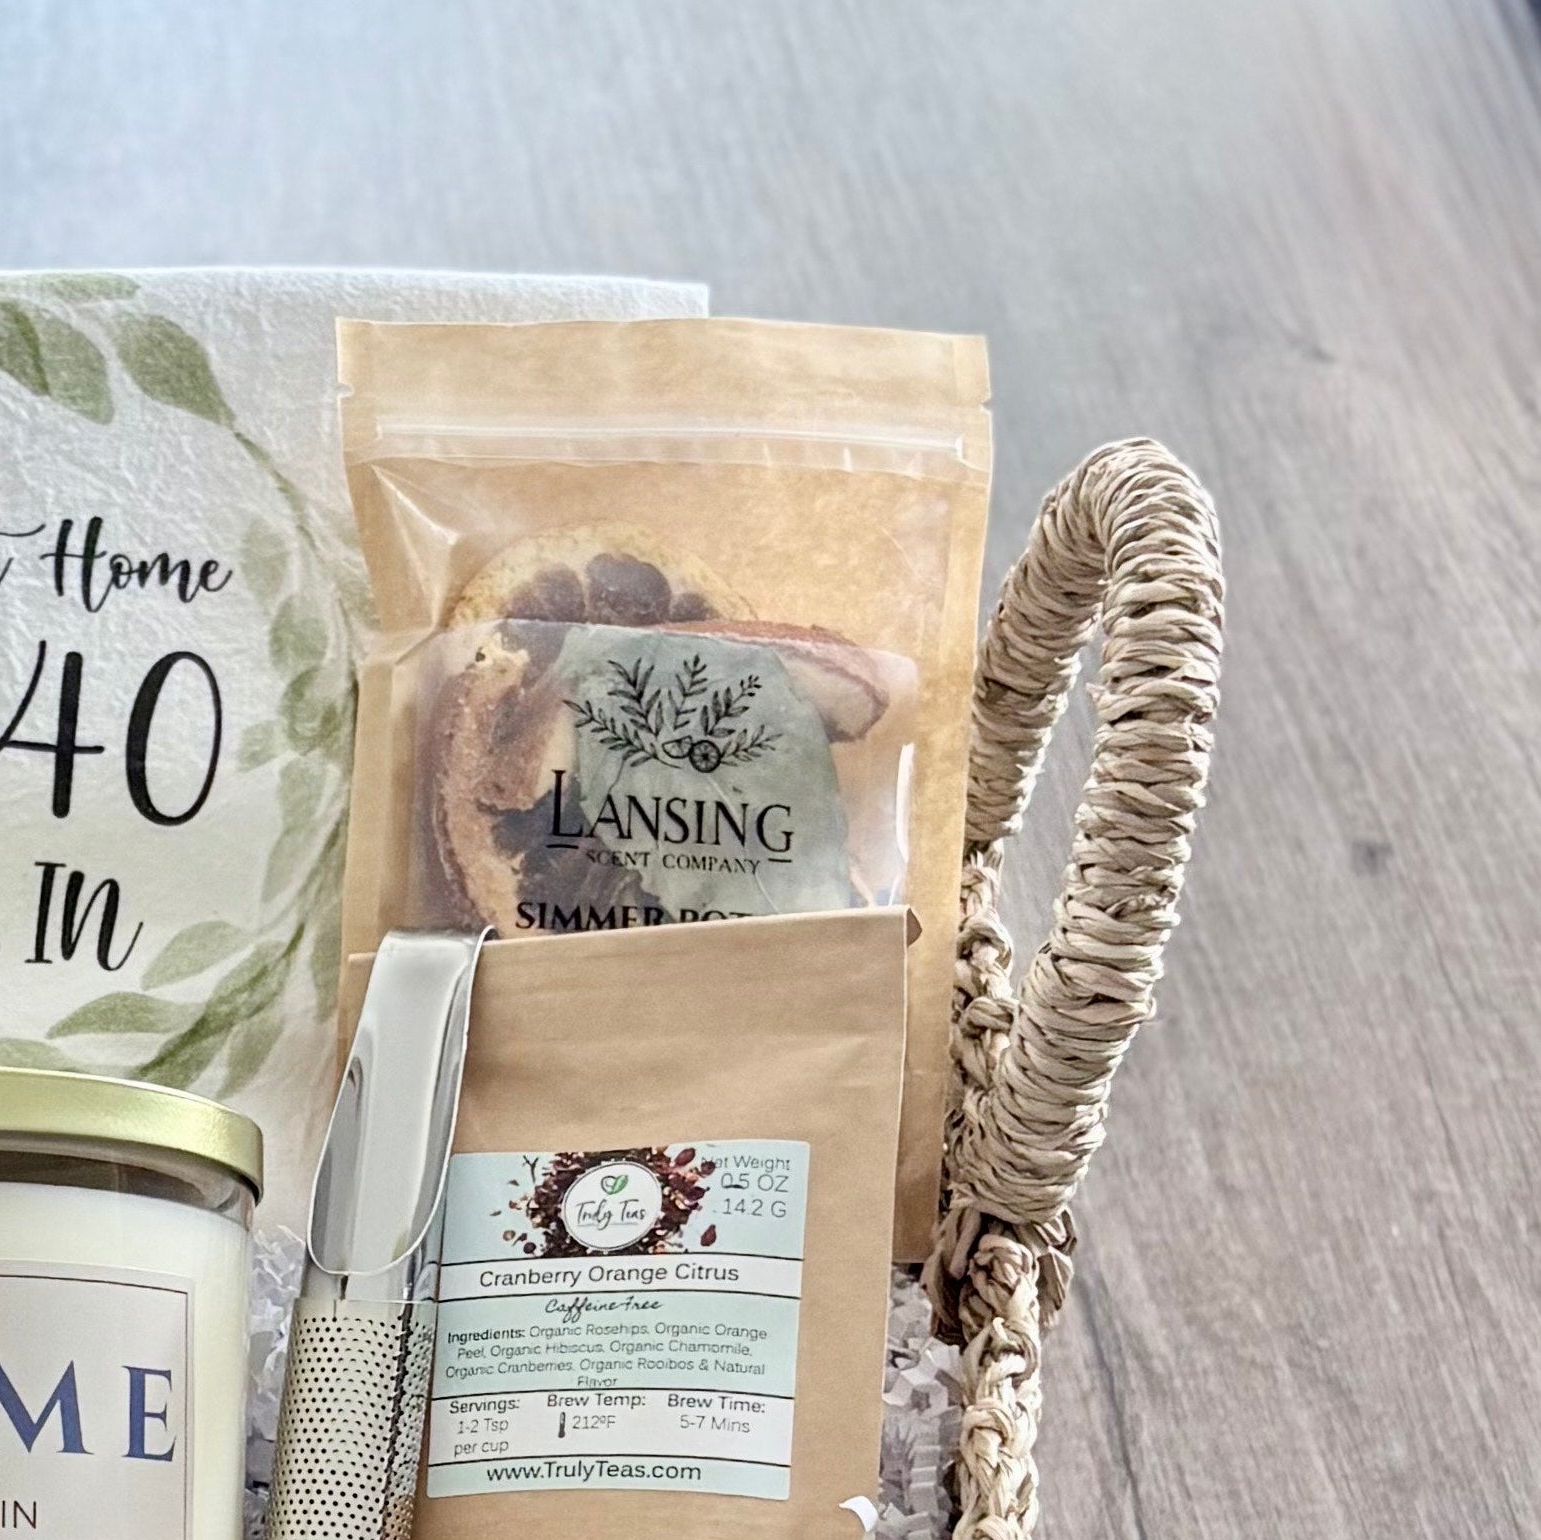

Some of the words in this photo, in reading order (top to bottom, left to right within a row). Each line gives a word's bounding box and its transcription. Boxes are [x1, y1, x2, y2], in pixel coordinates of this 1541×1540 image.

[40, 515, 232, 613] Home
[548, 769, 796, 854] LANSING
[585, 850, 652, 869] SCENT
[662, 852, 761, 875] COMPANY
[24, 861, 144, 971] IN
[515, 901, 665, 931] SIMMER
[733, 1154, 791, 1173] Weight
[757, 1173, 789, 1193] OZ
[620, 1198, 646, 1222] Teas
[771, 1200, 787, 1218] G
[479, 1268, 582, 1288] Cranberry
[588, 1265, 668, 1285] Orange
[674, 1262, 740, 1282] Citrus
[447, 1328, 525, 1345] Ingredients:
[529, 1325, 582, 1340] Organic
[654, 1322, 710, 1338] Organic
[714, 1323, 768, 1342] Orange
[490, 1344, 542, 1360] Organic
[609, 1340, 664, 1355] Organic
[445, 1364, 494, 1380] Organic
[579, 1358, 633, 1374] Organic
[637, 1357, 695, 1371] Rooibos
[698, 1358, 709, 1371] &
[714, 1359, 765, 1375] Natural
[449, 1399, 520, 1415] Servings:
[547, 1393, 589, 1407] Brew
[596, 1393, 646, 1410] Temp:
[667, 1393, 713, 1408] Brew
[718, 1395, 766, 1413] Time:
[457, 1419, 479, 1434] 1-2
[484, 1417, 509, 1434] Tsp
[680, 1414, 706, 1429] 5-7
[711, 1416, 751, 1433] Mins
[454, 1443, 478, 1457] per
[481, 1440, 509, 1456] cup
[486, 1460, 702, 1482] www.TrulyTeas.com
[1, 1499, 39, 1530] IN
